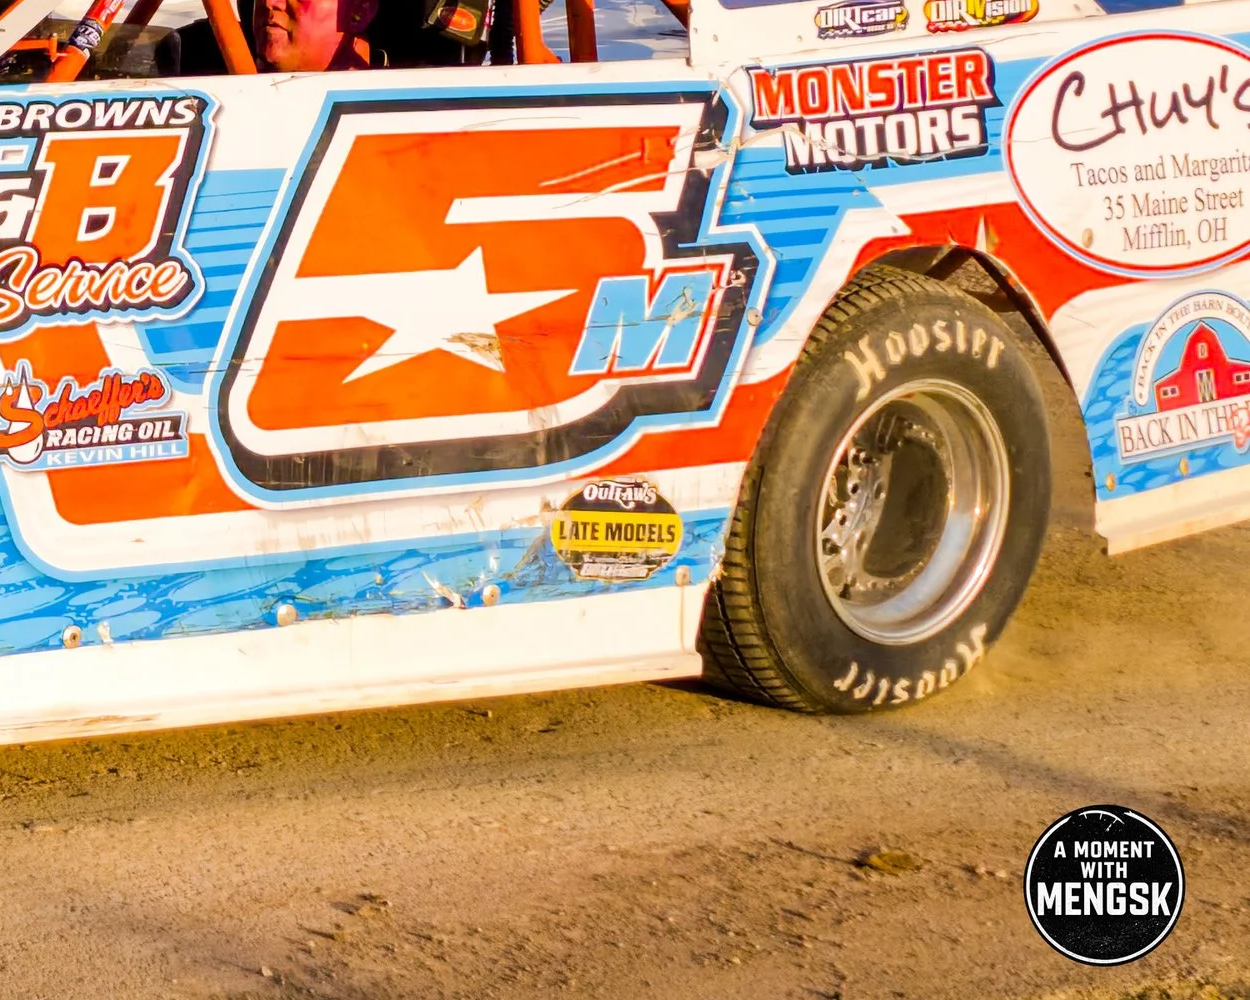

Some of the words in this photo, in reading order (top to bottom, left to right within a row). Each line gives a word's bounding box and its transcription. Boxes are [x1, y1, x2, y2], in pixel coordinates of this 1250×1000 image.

[750, 49, 996, 123] MONSTER
[784, 104, 987, 169] MOTORS
[1070, 161, 1128, 187] Tacos
[1134, 155, 1166, 182] and
[1104, 195, 1125, 221] 35
[1132, 190, 1188, 218] Maine
[1194, 187, 1244, 212] Street
[1122, 221, 1191, 251] Mifflin,
[1198, 217, 1228, 244] OH
[843, 318, 1007, 401] Hoosier
[1138, 344, 1157, 389] BACK
[1154, 324, 1168, 341] IN
[1169, 303, 1192, 324] THE
[1193, 299, 1225, 313] BARN
[46, 423, 134, 448] RACING
[137, 420, 175, 440] OIL
[1120, 416, 1175, 454] BACK
[1177, 412, 1199, 441] IN
[46, 447, 123, 466] KEVIN
[130, 442, 184, 459] HILL
[558, 520, 600, 541] LATE
[605, 522, 677, 543] MODELS
